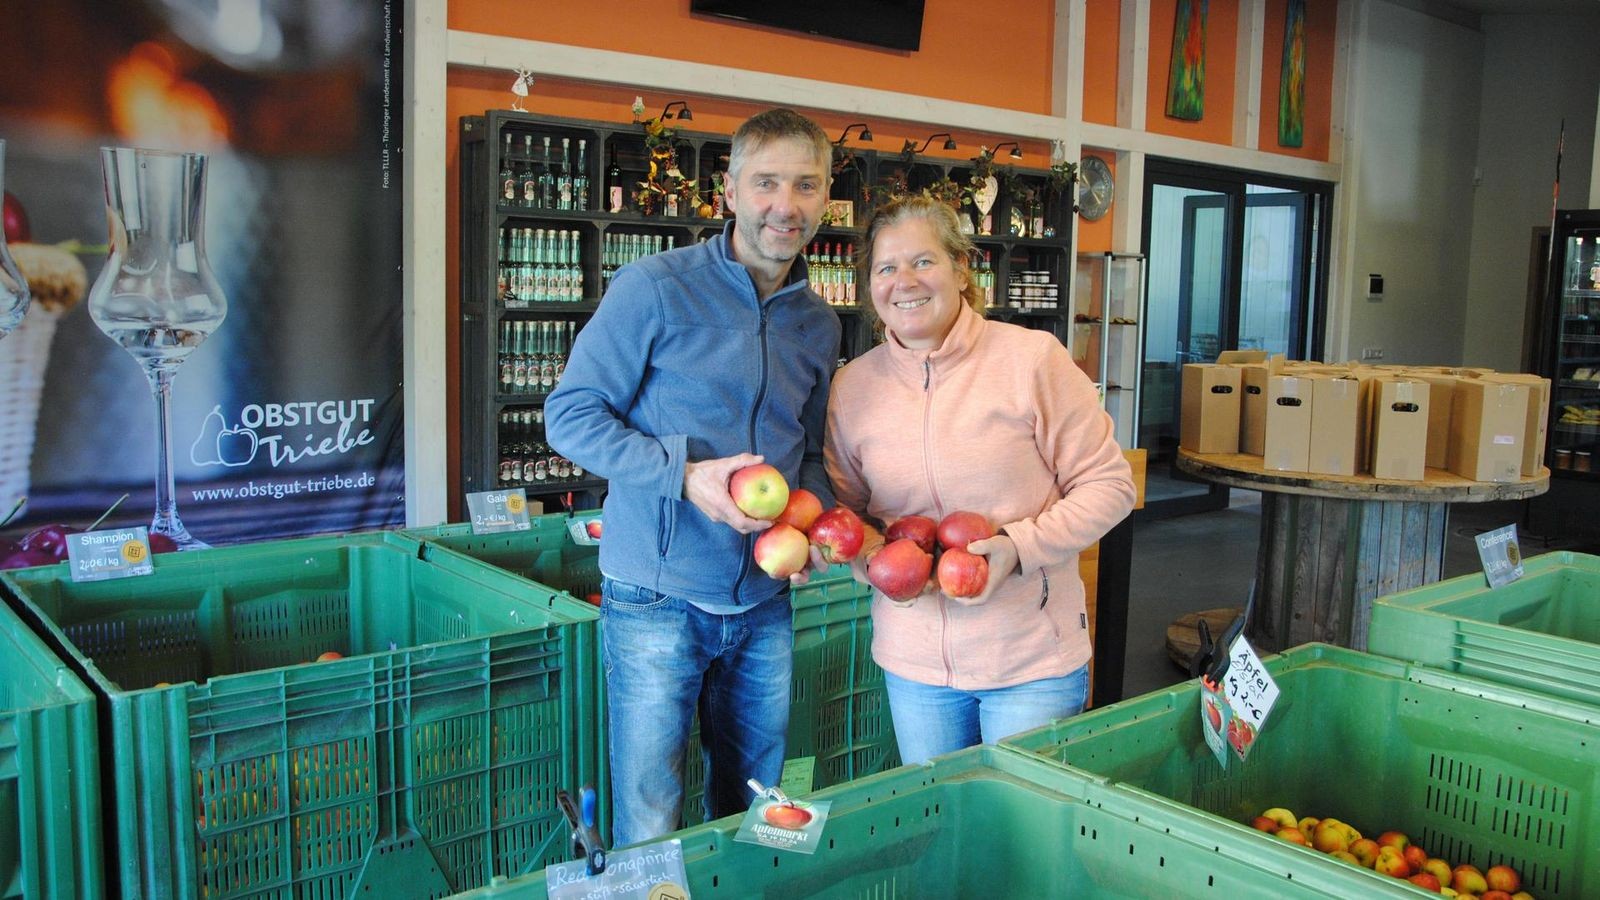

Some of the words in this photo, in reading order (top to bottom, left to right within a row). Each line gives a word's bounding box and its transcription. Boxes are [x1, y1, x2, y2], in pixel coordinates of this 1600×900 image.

[383, 5, 392, 57] Landwirtschaft
[383, 69, 391, 107] Landesamt
[382, 108, 391, 143] Thüringer
[241, 399, 375, 429] OBSTGUT
[258, 419, 375, 467] Triebe
[192, 472, 376, 501] www.obstgut-triebe.de
[486, 494, 507, 504] Gala
[81, 532, 134, 546] Shampion
[1480, 530, 1513, 549] Conference
[1238, 650, 1268, 693] Äpfel
[751, 823, 809, 842] Apfelmarkt
